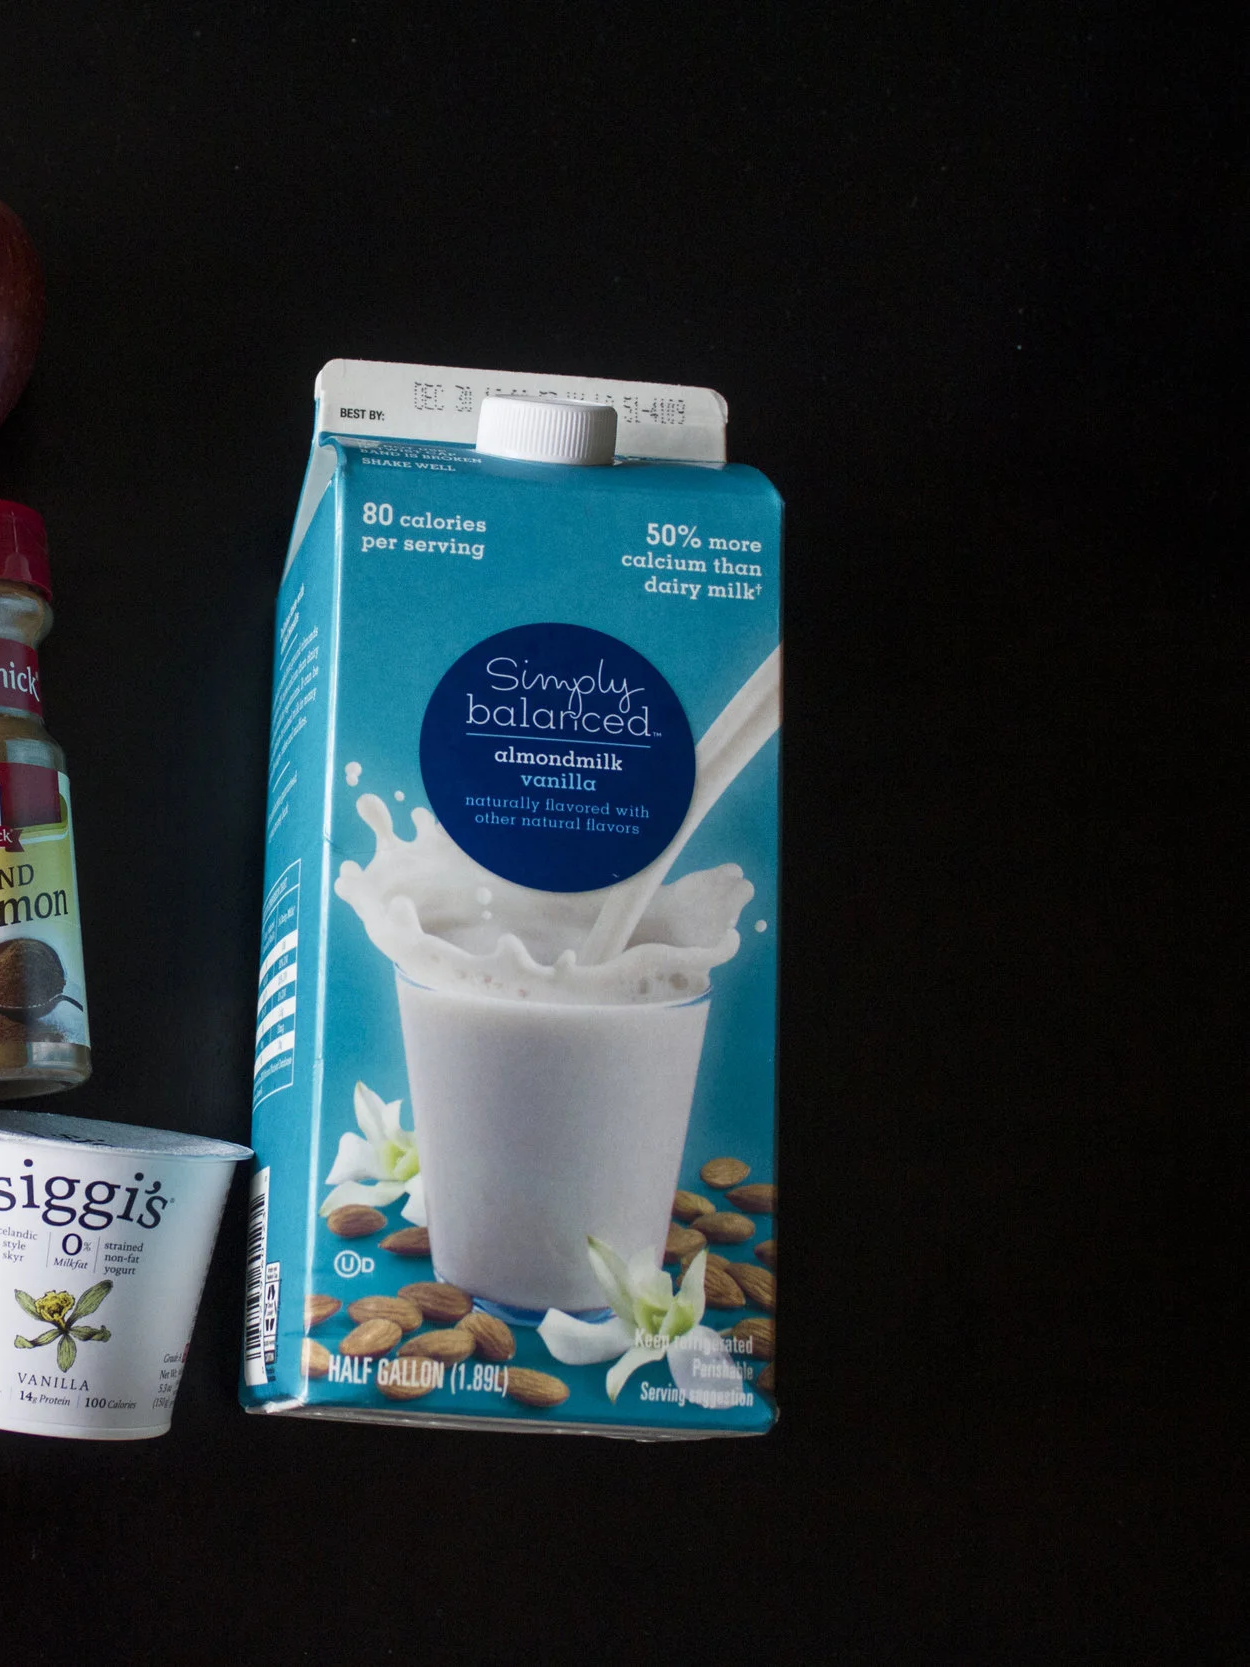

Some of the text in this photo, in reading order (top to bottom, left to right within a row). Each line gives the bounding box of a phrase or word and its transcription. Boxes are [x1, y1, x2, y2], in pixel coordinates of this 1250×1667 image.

[340, 407, 385, 421] BEST BY:
[362, 457, 456, 472] SHAKE WELL
[363, 502, 487, 533] 80 calories
[361, 536, 485, 560] per serving
[646, 522, 762, 553] 50% more
[621, 551, 762, 577] calcium than
[644, 575, 701, 600] dairy
[486, 657, 645, 719] Simply
[494, 746, 623, 771] almondmilk
[520, 773, 597, 791] vanilla
[465, 795, 650, 819] naturally flavored with
[475, 811, 640, 835] other natural flavors
[2, 1240, 26, 1251] style
[2, 1251, 25, 1263] skyr
[104, 1241, 144, 1253] strained
[53, 1257, 89, 1271] Milkfat
[104, 1253, 140, 1264] non-fat
[104, 1265, 136, 1276] yogurt
[635, 1327, 753, 1355] Keep refrigerated
[328, 1354, 509, 1398] HALF GALLON (1.89L)
[692, 1357, 754, 1381] Perishable
[18, 1372, 90, 1392] VANILLA
[39, 1393, 71, 1407] Protein
[85, 1397, 137, 1410] 100 Calories
[640, 1381, 754, 1409] Serving suggestion
